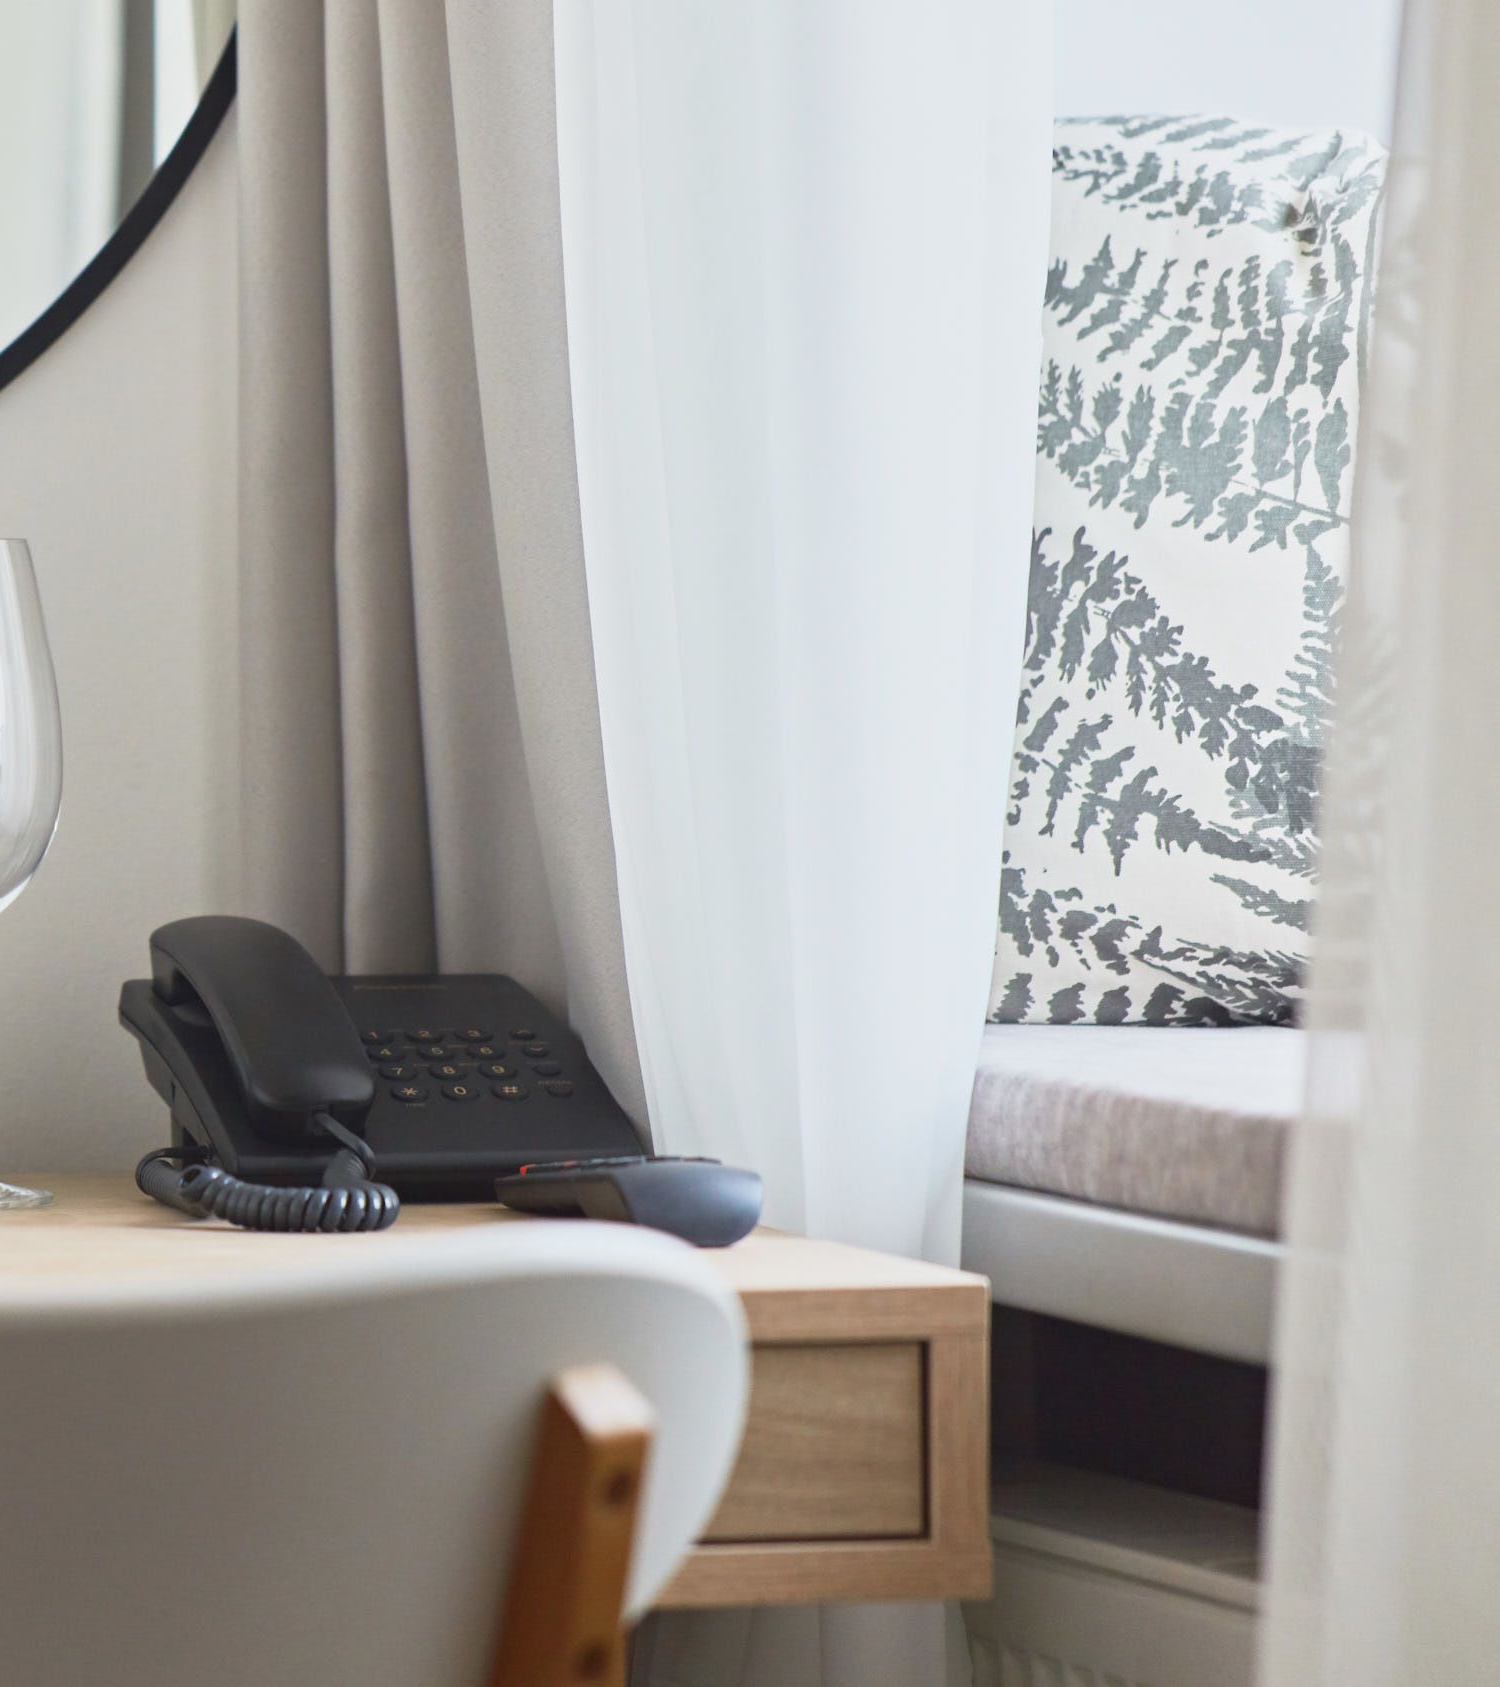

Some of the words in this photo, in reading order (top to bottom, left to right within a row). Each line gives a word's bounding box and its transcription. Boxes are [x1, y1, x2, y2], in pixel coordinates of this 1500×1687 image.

[419, 1030, 431, 1038] 2
[467, 1030, 481, 1038] 3
[379, 1048, 392, 1056] 4
[431, 1047, 444, 1055] 5
[479, 1047, 493, 1055] 6
[390, 1066, 403, 1075] 7
[442, 1066, 456, 1075] 8
[491, 1065, 505, 1074] 9
[453, 1086, 467, 1095] 0
